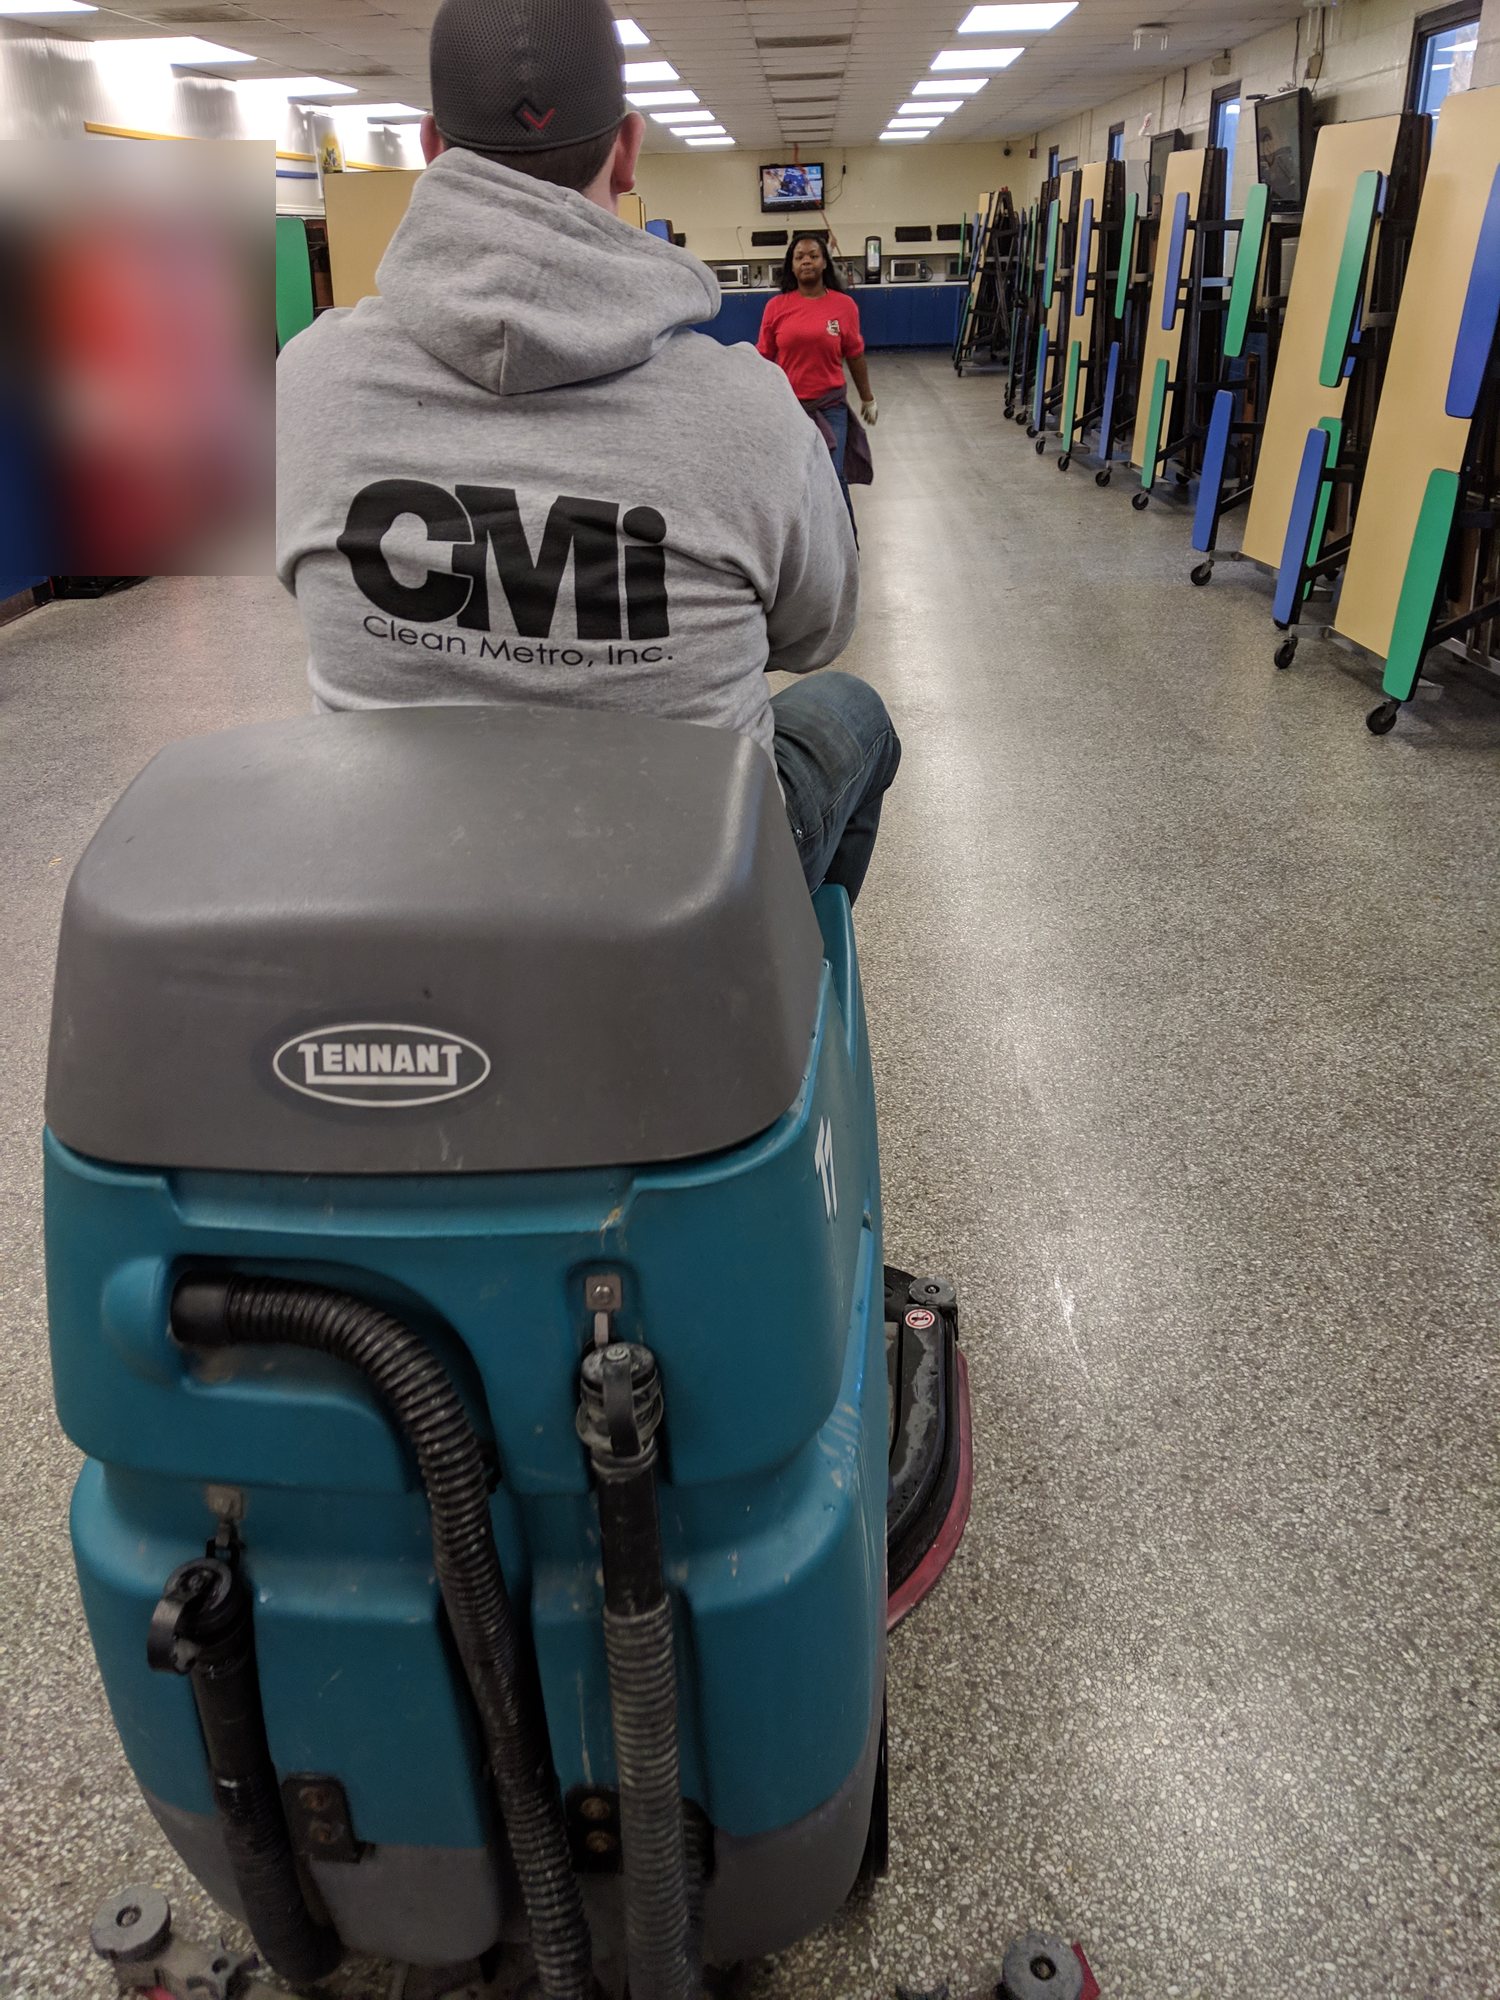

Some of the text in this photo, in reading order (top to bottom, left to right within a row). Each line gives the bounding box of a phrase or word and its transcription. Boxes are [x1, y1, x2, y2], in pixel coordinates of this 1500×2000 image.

[336, 479, 670, 640] CMi
[363, 615, 674, 668] Clean Metro, Inc.
[297, 1043, 462, 1085] TENNANT
